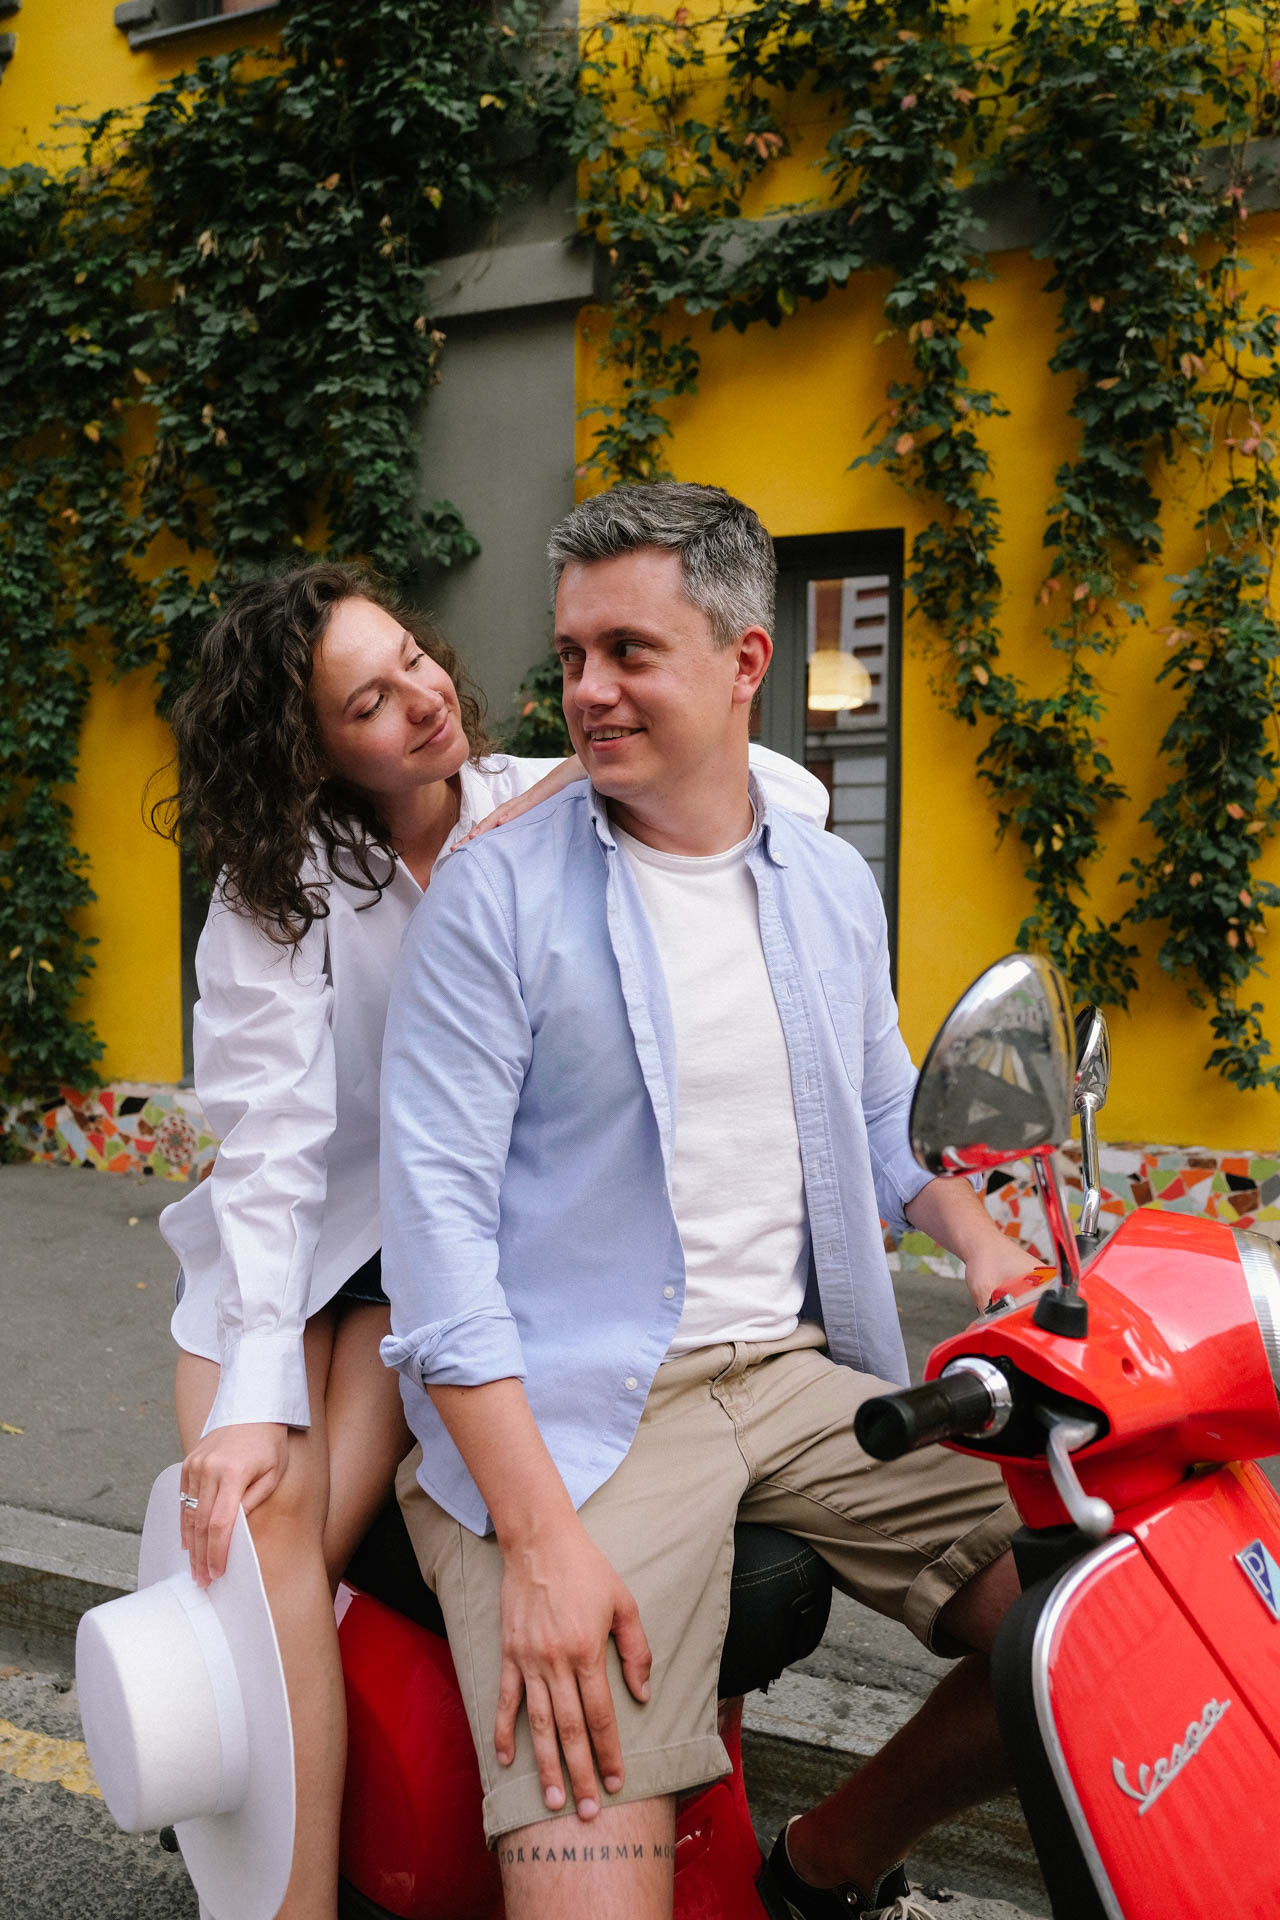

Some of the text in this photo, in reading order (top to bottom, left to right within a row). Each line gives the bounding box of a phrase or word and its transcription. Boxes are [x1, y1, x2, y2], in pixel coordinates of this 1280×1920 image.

[1243, 1551, 1271, 1595] P
[1111, 1697, 1232, 1817] Vespa
[532, 1844, 643, 1862] КАМНЯМИ
